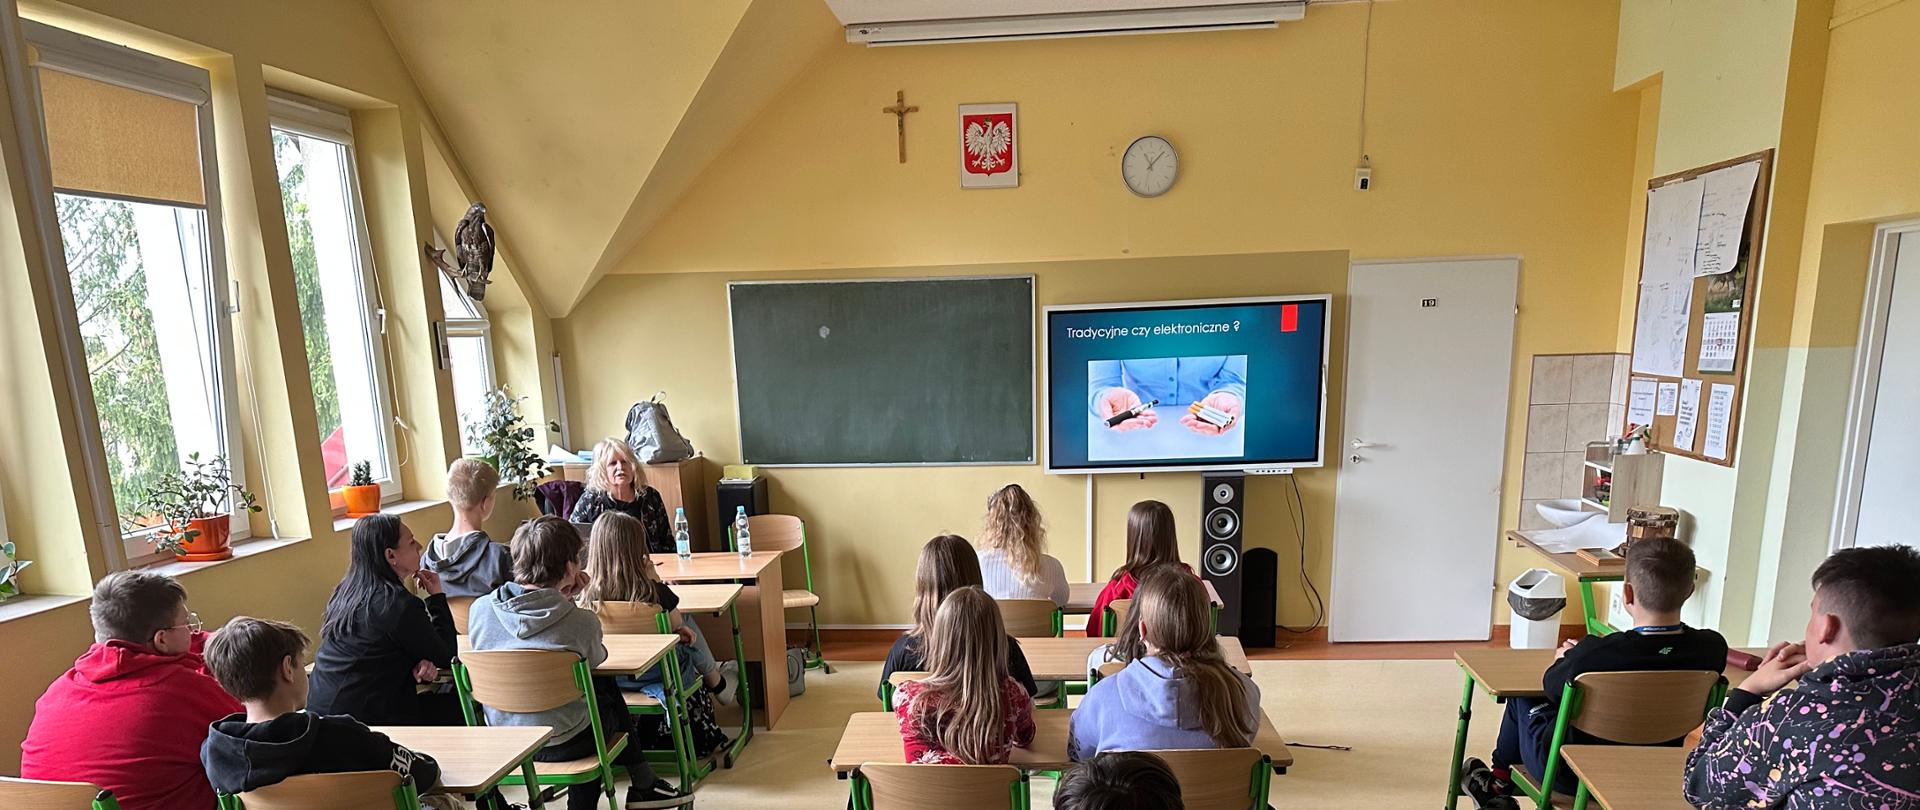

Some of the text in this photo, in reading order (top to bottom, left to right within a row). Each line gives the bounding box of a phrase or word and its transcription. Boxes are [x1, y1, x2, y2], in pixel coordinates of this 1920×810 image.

[1066, 320, 1240, 340] Tradycyjne czy elektroniczne ?
